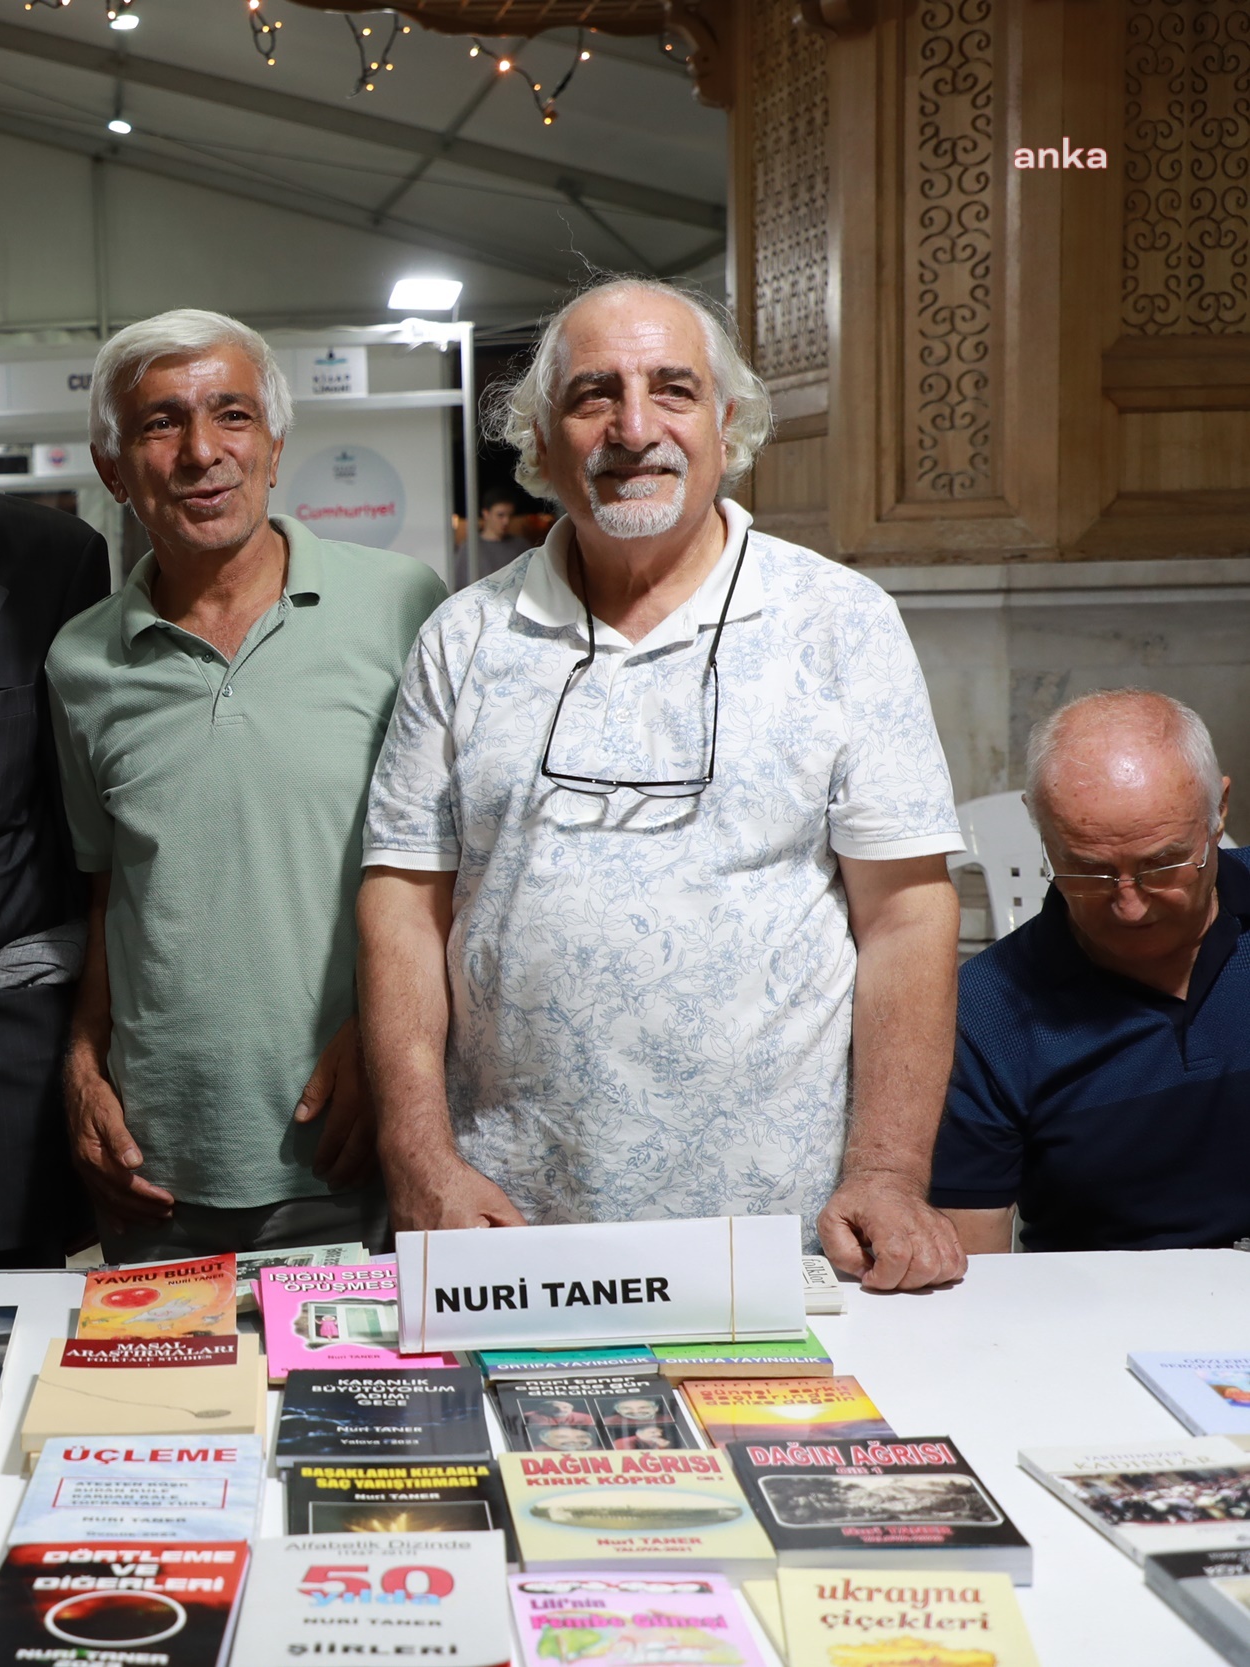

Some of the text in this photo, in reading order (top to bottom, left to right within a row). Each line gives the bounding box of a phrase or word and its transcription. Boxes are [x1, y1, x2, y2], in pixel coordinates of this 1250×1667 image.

[295, 502, 396, 520] Cumhuriyet
[94, 1262, 225, 1285] YAVRU BULUT
[194, 1273, 225, 1282] TANER
[269, 1269, 398, 1284] IŞIĞIN SESL
[802, 1258, 828, 1284] folklor
[283, 1279, 398, 1293] ÖPÜŞMES
[434, 1277, 671, 1313] NURİ TANER
[66, 1345, 235, 1357] ARAŞTIRMALARI
[117, 1341, 187, 1351] MASAL
[559, 1358, 649, 1368] YAYINCILIK
[729, 1356, 821, 1364] YAYINCILIK
[573, 1376, 635, 1385] taner
[311, 1385, 456, 1393] BÜYÜTÜYORUM
[62, 1446, 239, 1464] ÜÇLEME
[747, 1440, 957, 1467] DAĞIN AĞRISI
[520, 1452, 722, 1475] DAĞIN AĞRISI
[1072, 1455, 1218, 1471] KADINLAR
[301, 1466, 490, 1479] BAŞAKLARIN KIZLARLA
[526, 1475, 591, 1486] KIRIK
[596, 1473, 677, 1486] KÖPRÜ
[316, 1477, 478, 1491] SAÇ YARIŞTIRMASI
[885, 1525, 954, 1536] TANER
[285, 1539, 472, 1550] Alfabetik Dizinde
[597, 1536, 703, 1546] Nuri TANER
[41, 1548, 237, 1564] DÖRTLEME
[109, 1563, 159, 1576] VE
[32, 1575, 225, 1592] DİĞERLERİ
[297, 1565, 455, 1601] 50
[309, 1588, 442, 1607] yılda
[815, 1578, 985, 1609] ukrayna
[368, 1617, 443, 1627] TANER
[530, 1613, 729, 1631] Pembe Güneşi
[819, 1609, 992, 1632] çiçekleri
[15, 1648, 170, 1666] NURİ TANER
